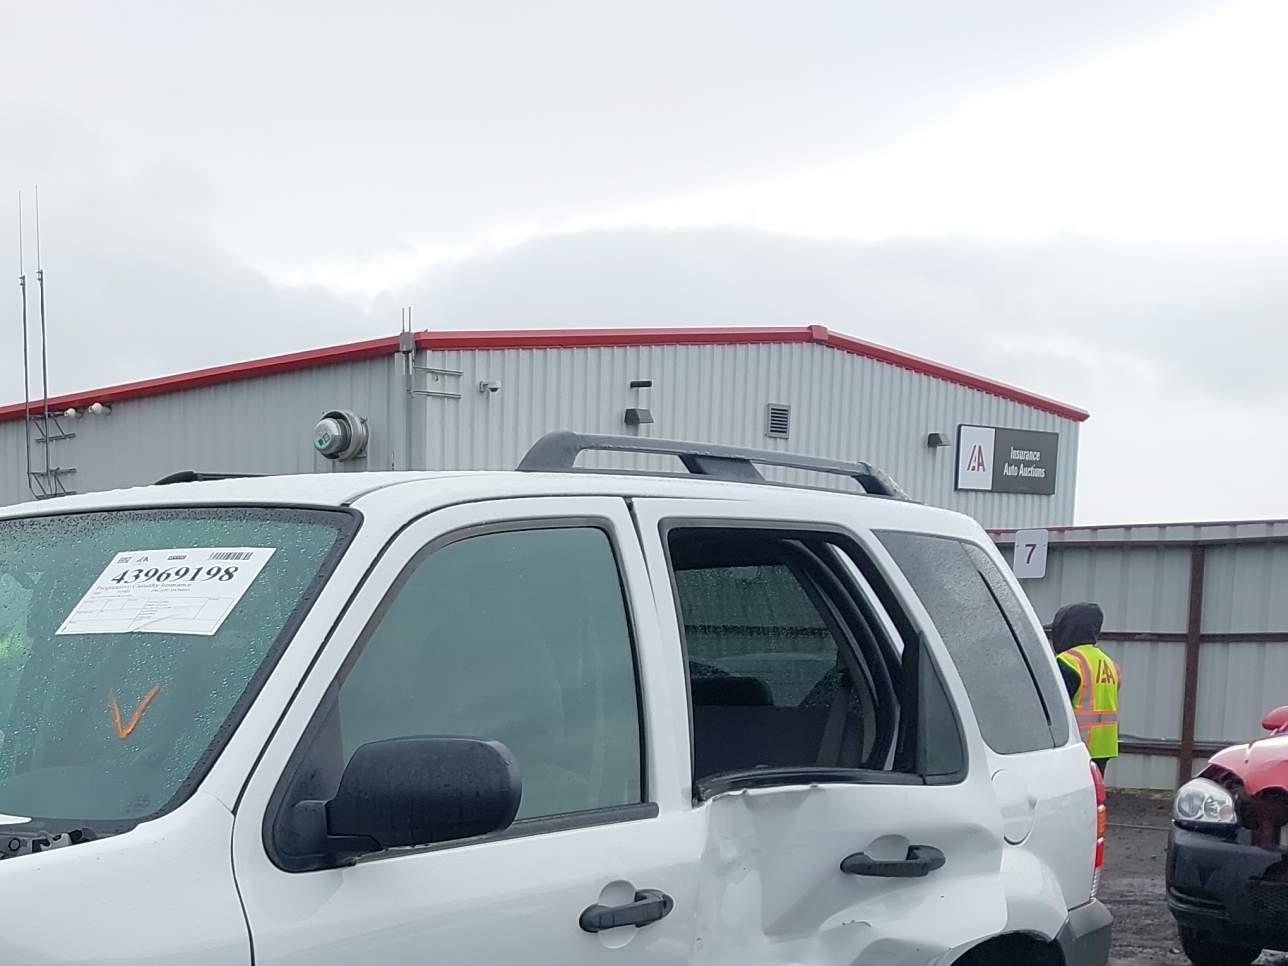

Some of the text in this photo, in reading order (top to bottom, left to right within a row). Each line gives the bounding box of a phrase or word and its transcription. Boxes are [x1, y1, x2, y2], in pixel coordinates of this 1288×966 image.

[1011, 447, 1040, 461] Insurance
[1003, 463, 1046, 477] Auto Auctions
[1025, 544, 1037, 564] 7
[112, 566, 239, 584] 43969198
